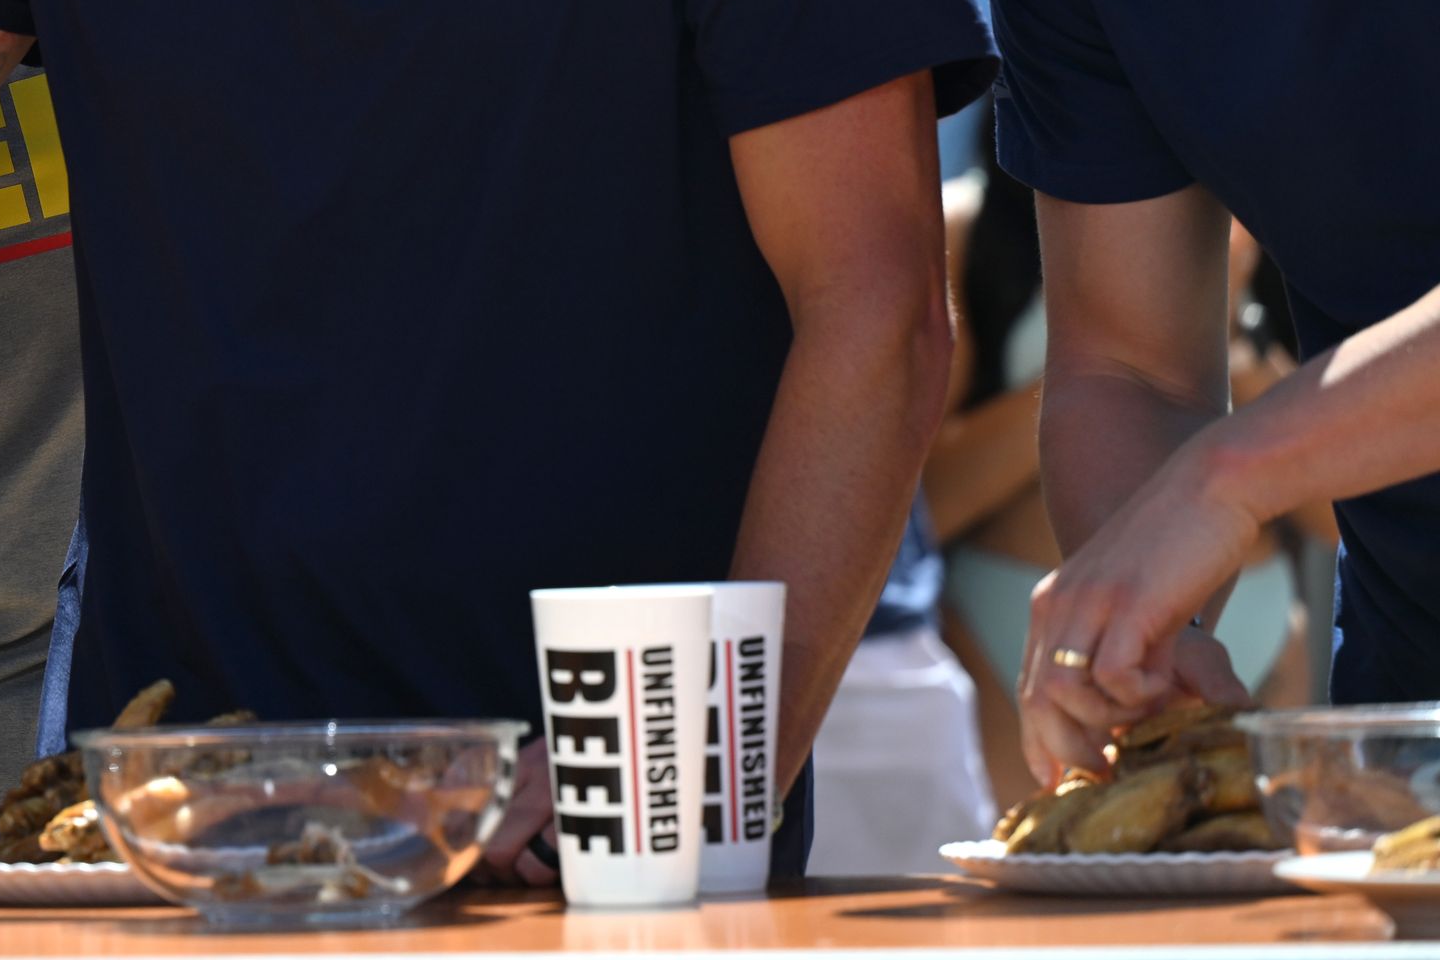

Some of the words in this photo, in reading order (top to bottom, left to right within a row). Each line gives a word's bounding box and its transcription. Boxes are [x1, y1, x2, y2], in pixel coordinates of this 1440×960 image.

[546, 648, 624, 855] BEEF
[641, 645, 679, 854] UNFINISHED
[738, 637, 766, 843] UNFINISHED
